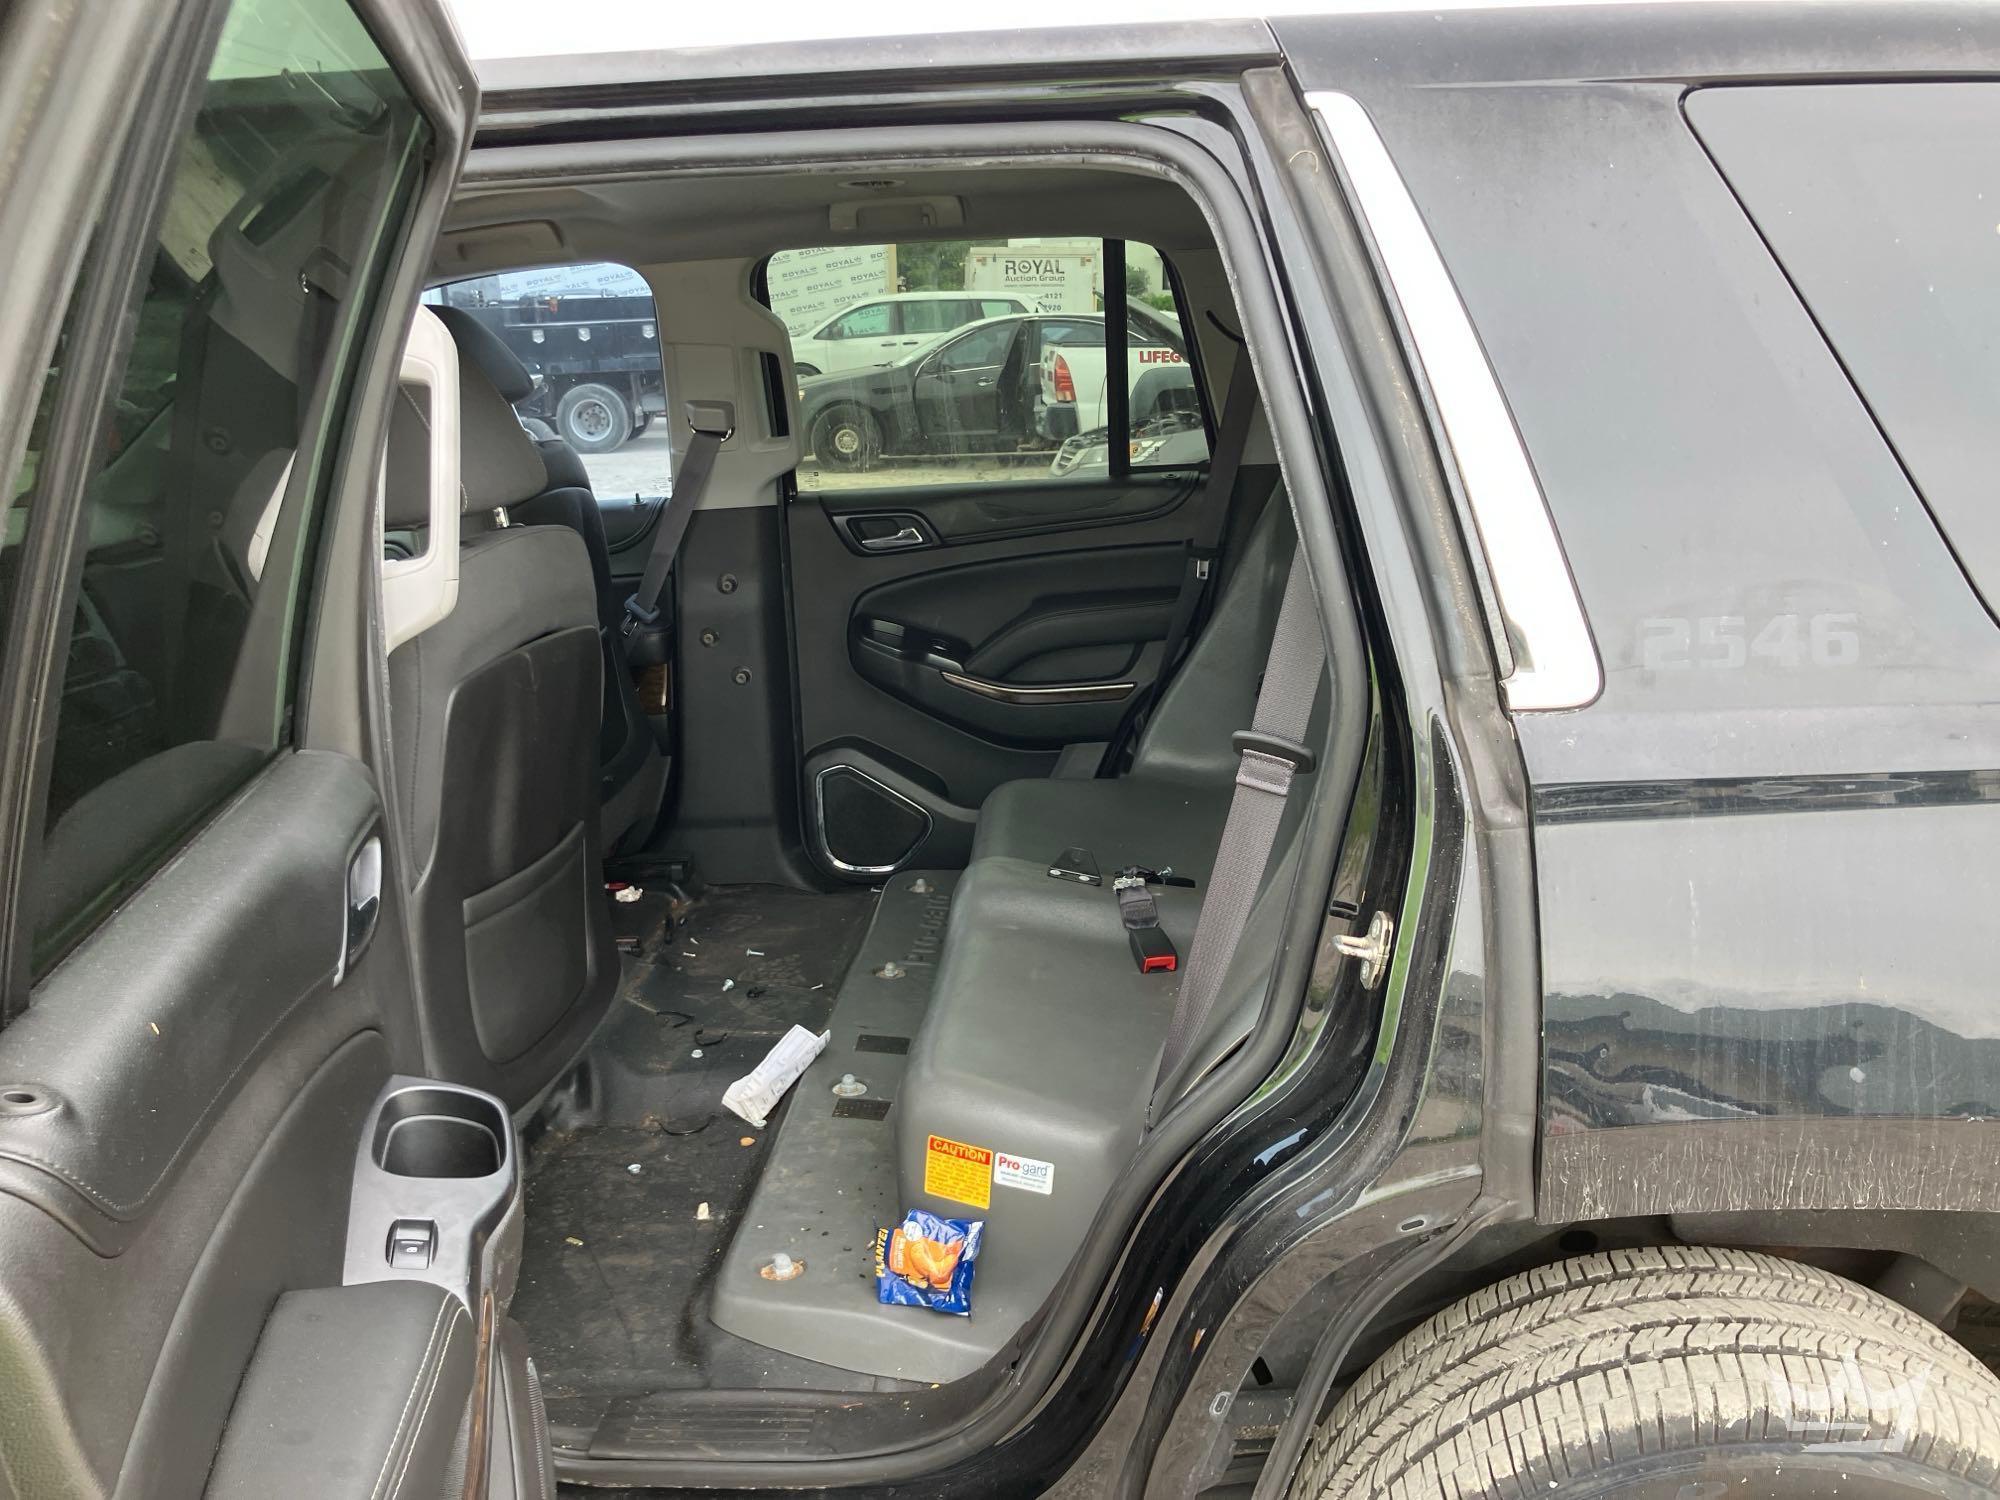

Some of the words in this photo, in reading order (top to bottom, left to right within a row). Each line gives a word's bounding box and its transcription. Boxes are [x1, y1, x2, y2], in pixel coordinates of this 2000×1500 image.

[1005, 259, 1065, 275] ROYAL
[1039, 275, 1065, 283] Group
[1640, 612, 1860, 671] 2546
[933, 1140, 987, 1163] CAUTION
